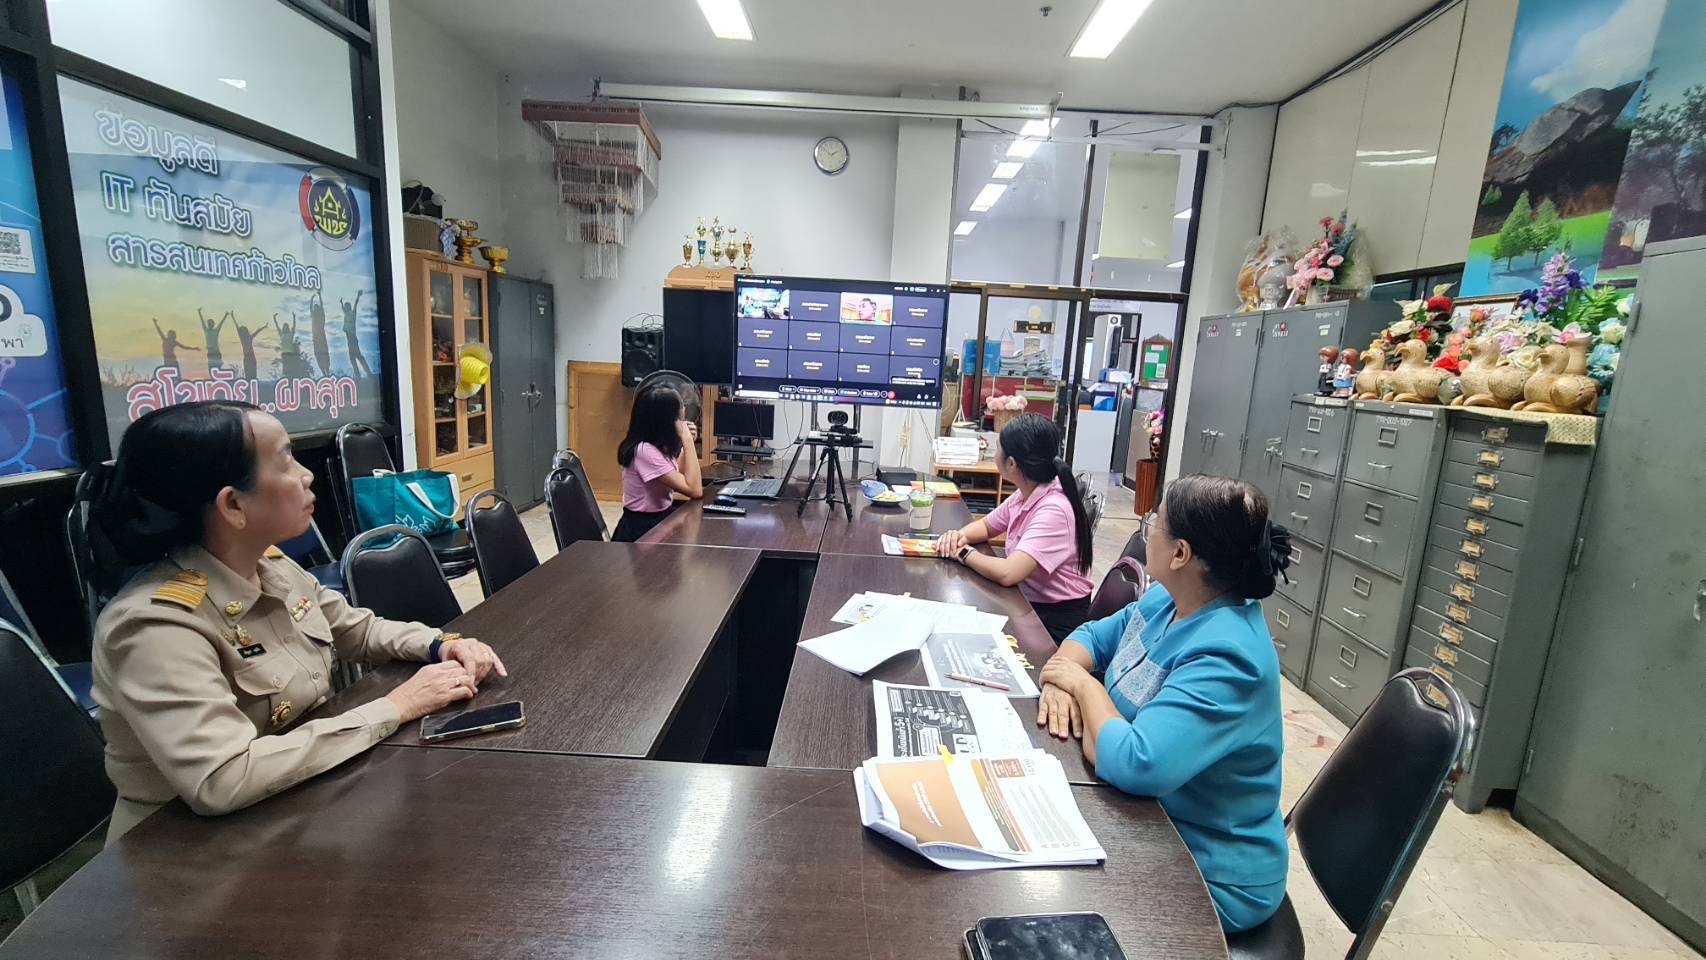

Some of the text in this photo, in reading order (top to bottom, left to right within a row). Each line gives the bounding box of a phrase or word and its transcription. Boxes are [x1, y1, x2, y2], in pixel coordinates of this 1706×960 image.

[102, 172, 134, 213] IT
[145, 178, 252, 237] ทันสมัย
[108, 233, 321, 289] สารสนเทศก้าวไกล
[127, 367, 357, 422] สโขทัย..ผาสุก
